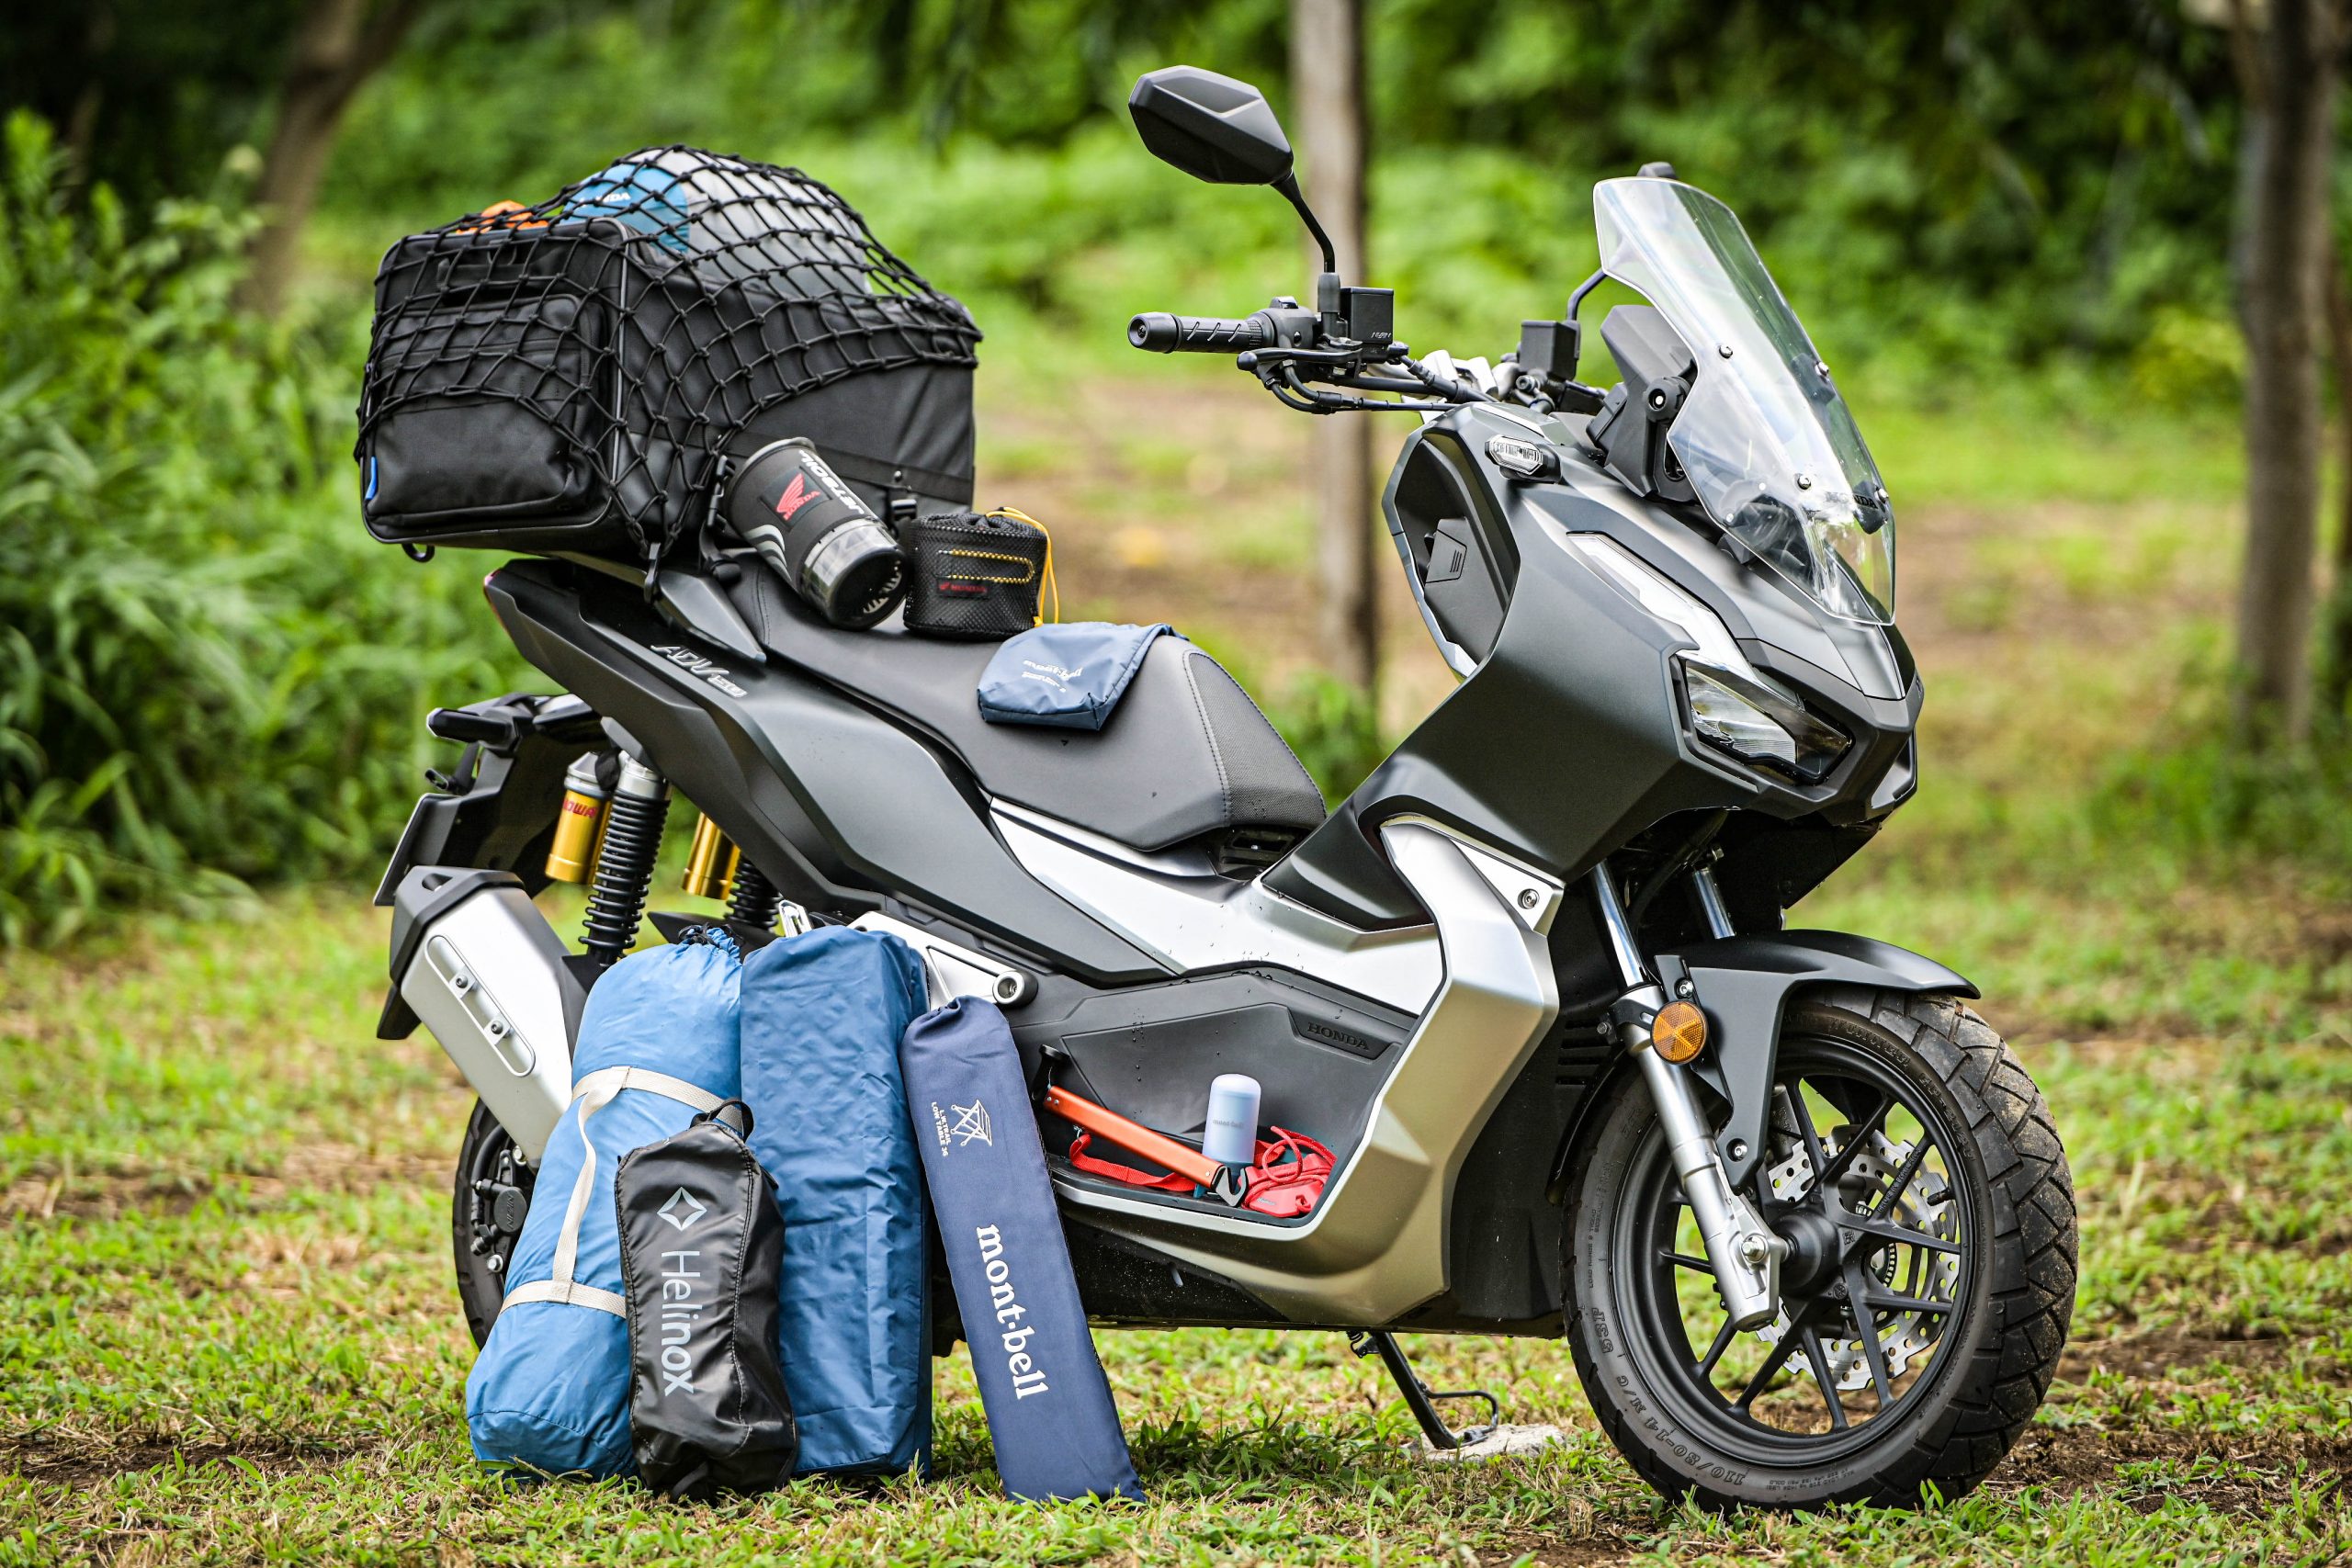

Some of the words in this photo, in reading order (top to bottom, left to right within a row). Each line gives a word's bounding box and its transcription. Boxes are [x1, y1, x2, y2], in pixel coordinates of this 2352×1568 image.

[798, 449, 865, 514] JETBOIL
[782, 490, 821, 522] HONDA
[650, 645, 730, 675] ADV
[1306, 1021, 1370, 1051] HONDA
[931, 1101, 940, 1120] LOW
[935, 1120, 946, 1146] TABLE
[661, 1250, 703, 1397] Helinox
